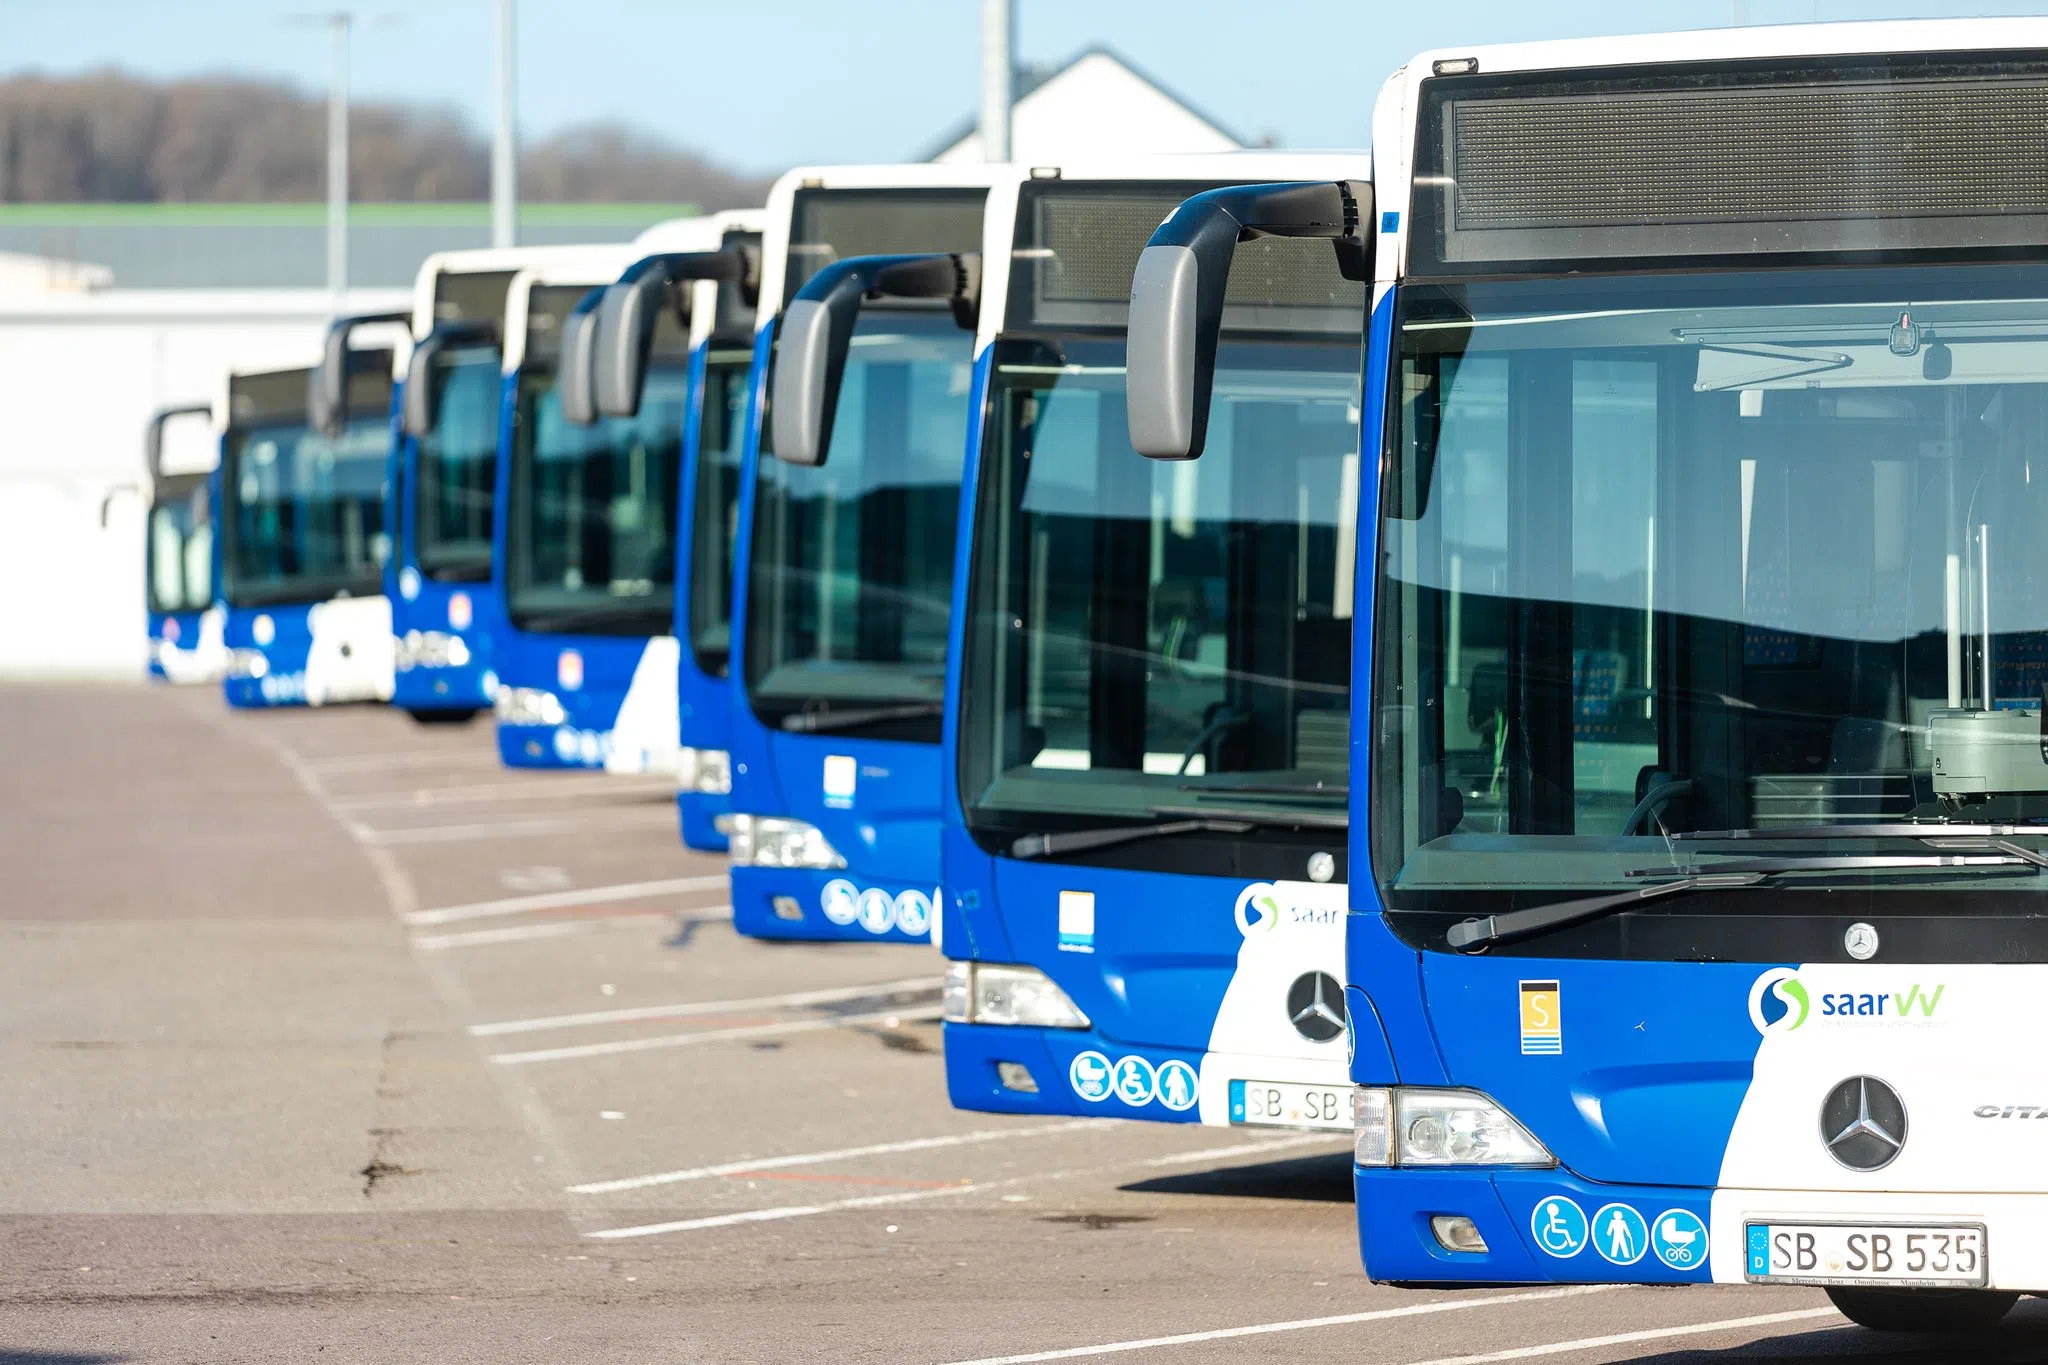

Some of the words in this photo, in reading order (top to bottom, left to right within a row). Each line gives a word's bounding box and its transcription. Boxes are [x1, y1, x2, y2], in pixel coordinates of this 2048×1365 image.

[1250, 1089, 1281, 1117] SB
[1305, 1092, 1337, 1120] SB
[1754, 1256, 1764, 1268] D
[1772, 1232, 1818, 1271] SB
[1846, 1234, 1893, 1272] SB
[1906, 1234, 1977, 1272] 535
